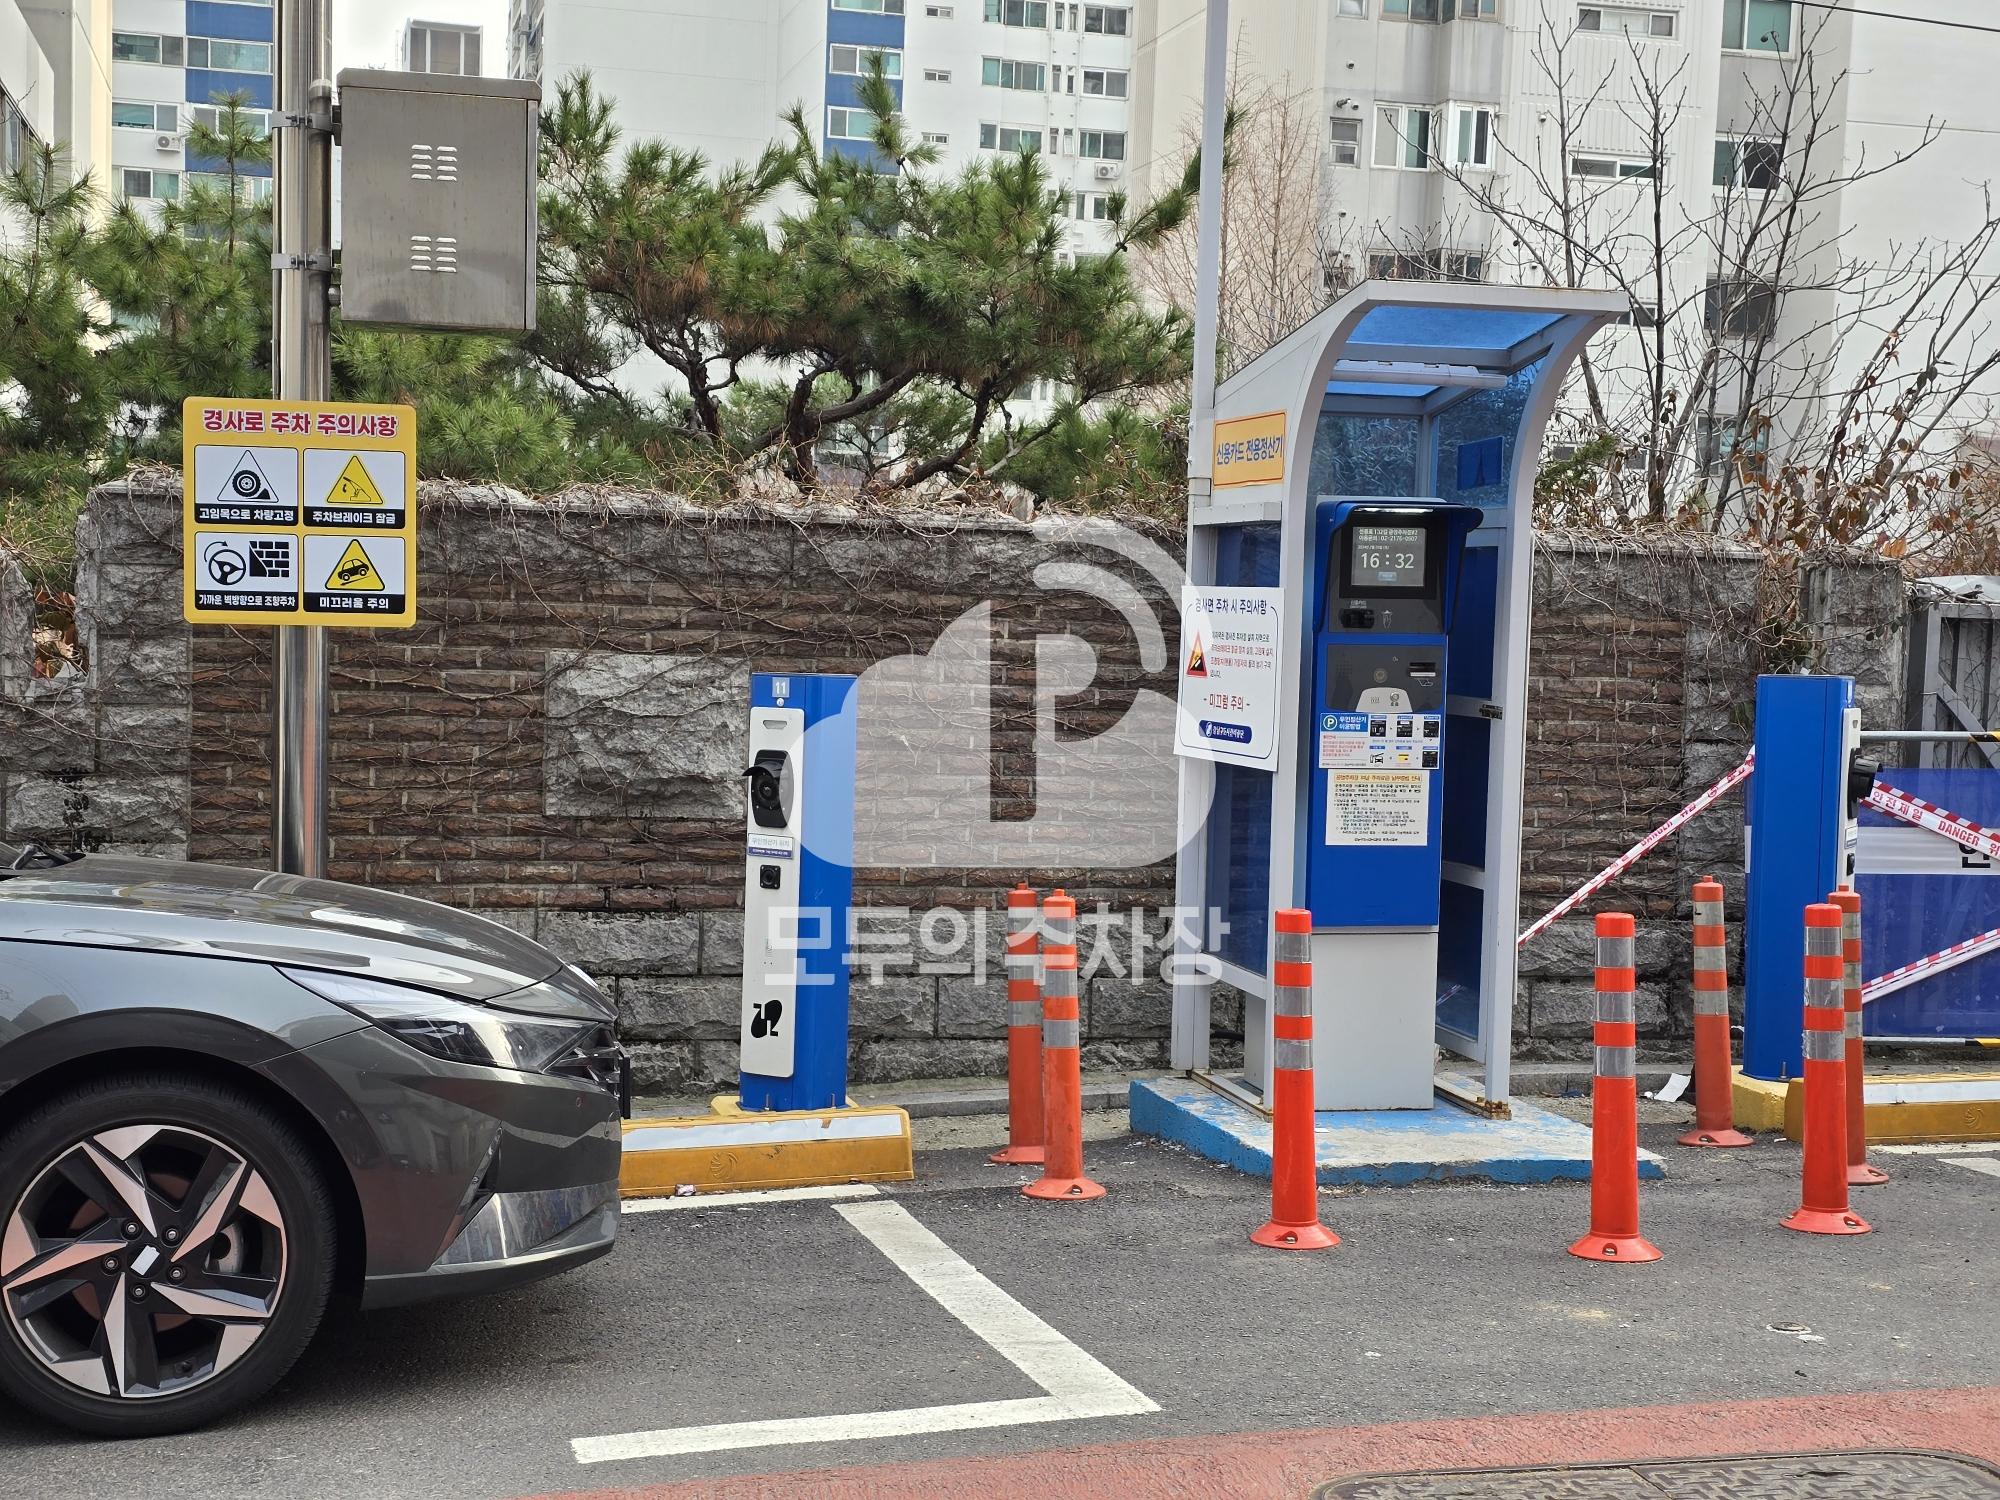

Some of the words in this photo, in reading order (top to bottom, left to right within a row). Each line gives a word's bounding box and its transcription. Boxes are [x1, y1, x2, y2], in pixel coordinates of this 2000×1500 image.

[203, 409, 264, 432] 경사로
[270, 411, 311, 434] 주차
[317, 414, 397, 437] 주의사항
[1217, 440, 1244, 465] 신용카드
[199, 508, 251, 520] 고임목으로
[254, 509, 294, 522] 차량고정
[313, 511, 373, 524] 주차브레이크
[376, 513, 396, 524] 잠금
[1361, 553, 1380, 568] 16
[1395, 553, 1414, 569] 32
[199, 595, 222, 605] 가까운
[224, 595, 262, 606] 벽방향으로
[264, 596, 296, 607] 조향주차
[320, 596, 363, 608] 미끄러움
[367, 597, 389, 609] 주의
[1196, 598, 1213, 612] 경사면
[1216, 598, 1229, 614] 주차
[1231, 598, 1237, 614] 시
[1240, 599, 1267, 615] 주의사항
[776, 681, 786, 694] 11
[1210, 693, 1228, 710] 미끄럼
[1231, 695, 1244, 712] 주의
[1937, 820, 1980, 846] DANGER
